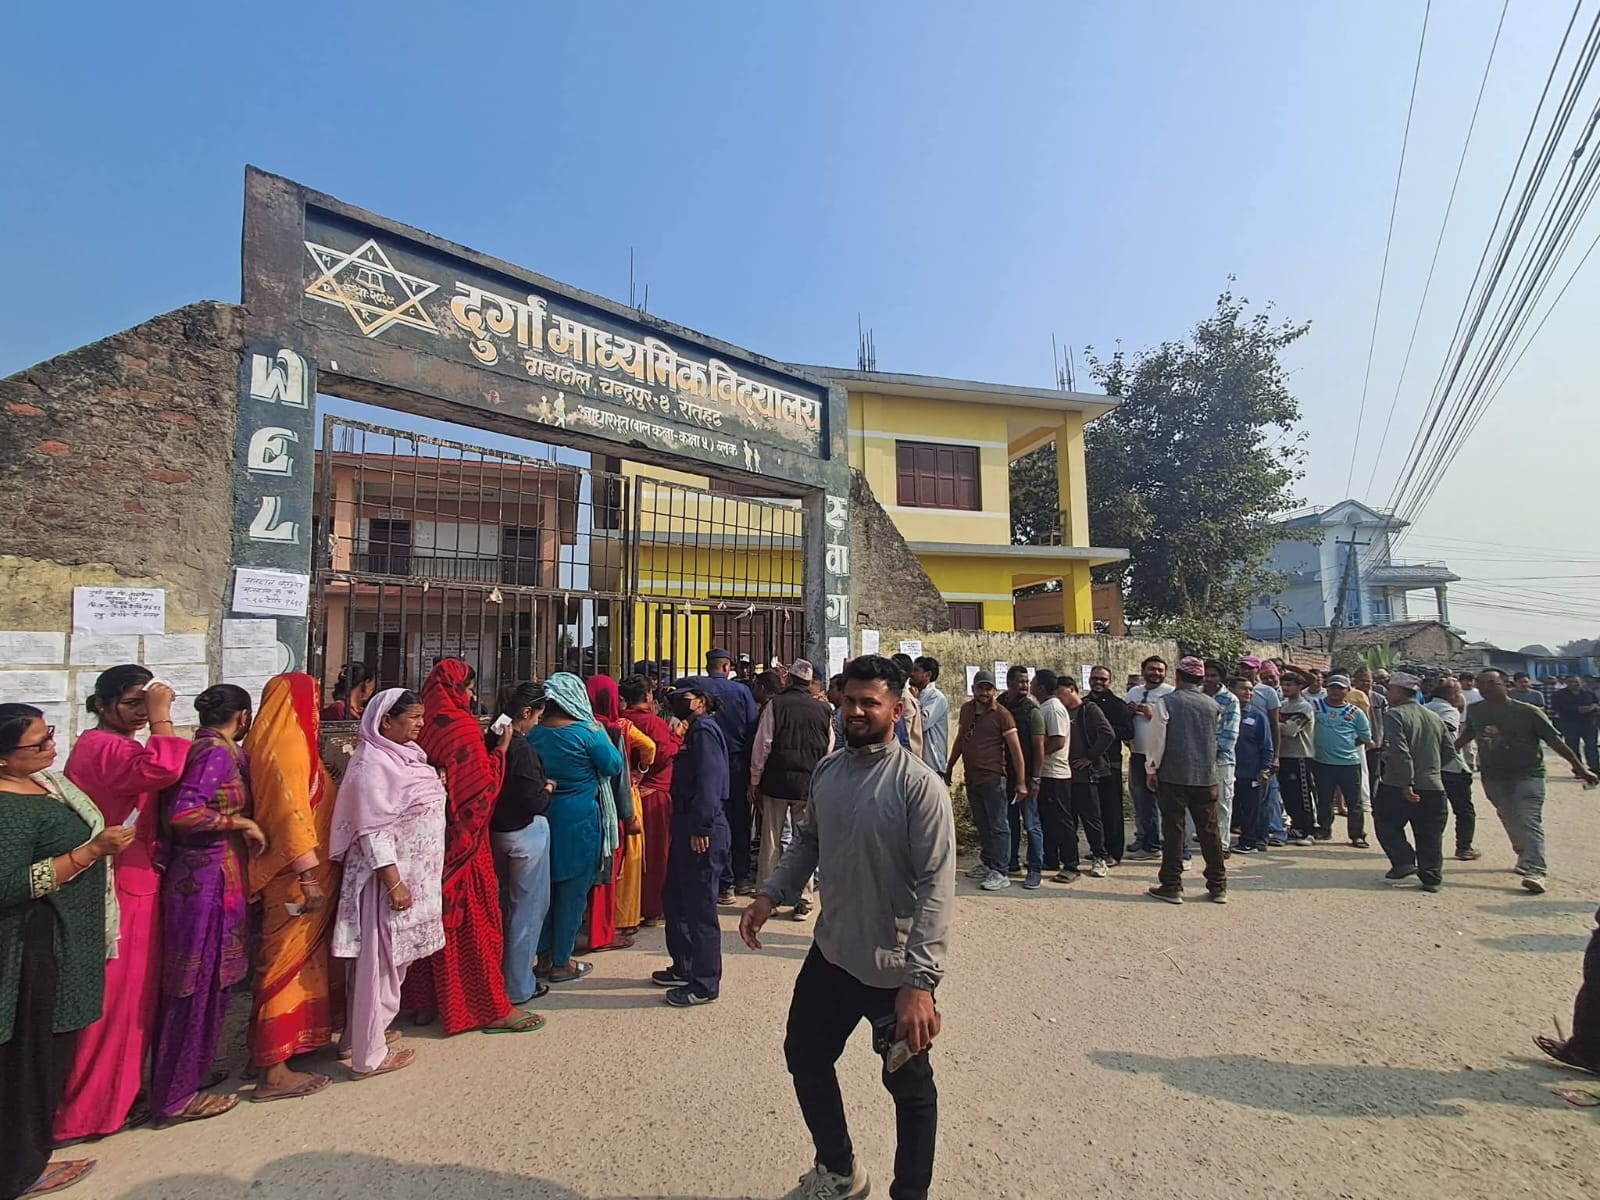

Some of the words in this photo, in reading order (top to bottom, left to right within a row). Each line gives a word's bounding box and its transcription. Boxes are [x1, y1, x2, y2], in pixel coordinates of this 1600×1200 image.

[322, 255, 331, 268] M
[366, 250, 374, 261] V
[450, 281, 548, 366] दुर्गा
[548, 314, 708, 397] माध्यमिक
[709, 357, 822, 431] विद्यालय
